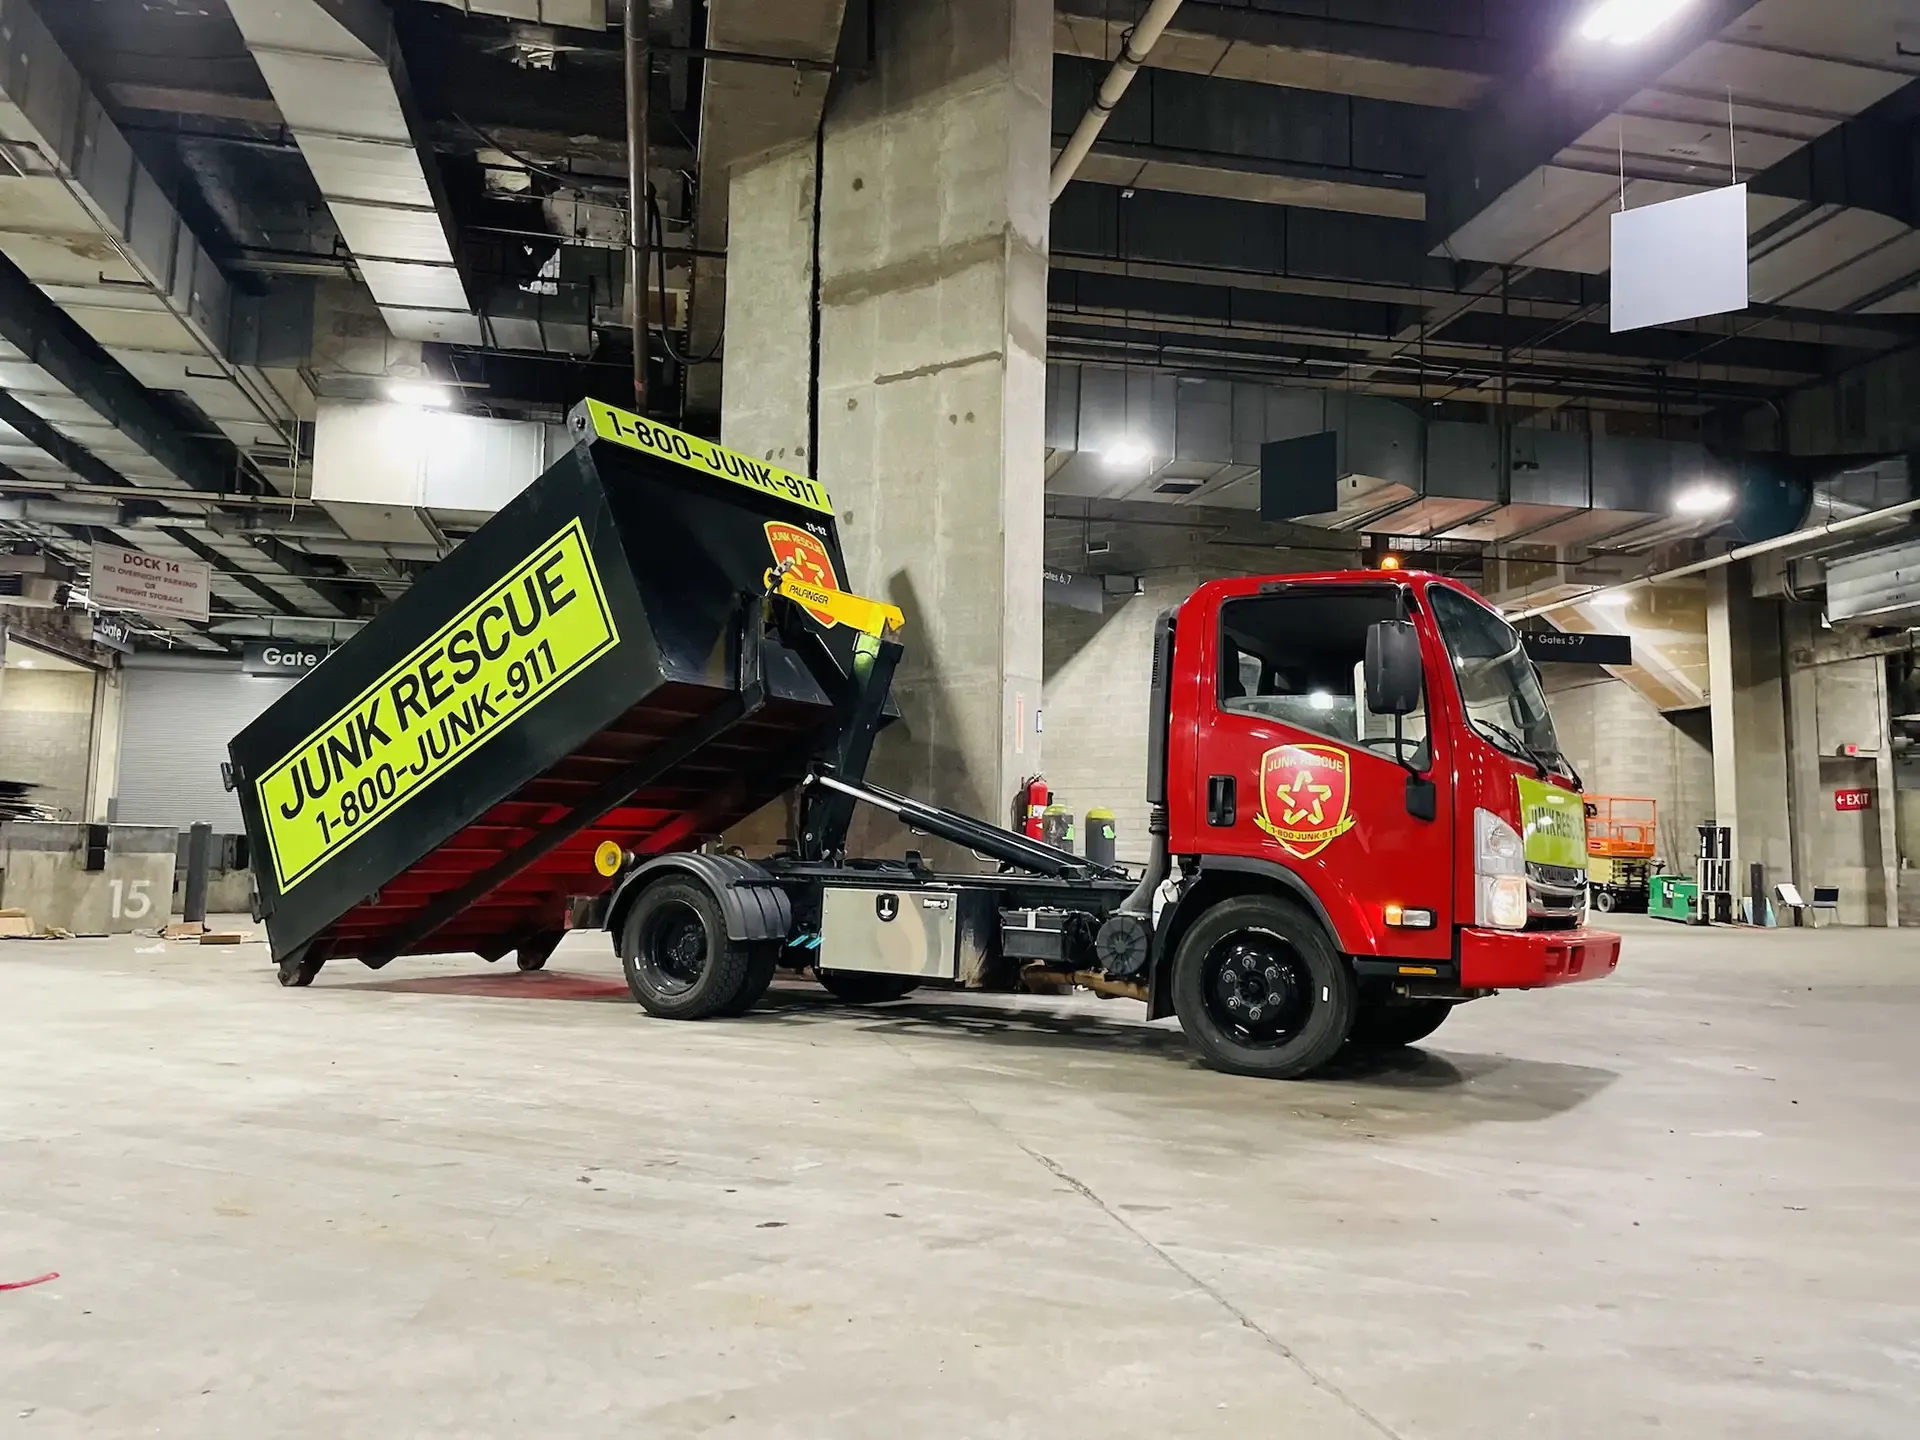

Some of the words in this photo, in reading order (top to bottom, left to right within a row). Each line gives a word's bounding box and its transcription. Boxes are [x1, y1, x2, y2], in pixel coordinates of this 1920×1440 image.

[606, 410, 821, 506] 1-800-JUNK-911
[771, 531, 793, 542] JUNK
[791, 533, 825, 557] RESCUE
[123, 553, 161, 571] DOCK
[165, 562, 180, 574] 14
[102, 564, 116, 573] NO
[117, 568, 162, 582] OVERNIGHT
[163, 577, 198, 589] PARKING
[144, 582, 156, 590] OR
[1043, 571, 1059, 582] ates
[116, 585, 147, 597] FREIGHT
[149, 591, 184, 604] STORAGE
[788, 584, 829, 605] PALFINGER
[101, 617, 122, 641] Gate
[1538, 634, 1566, 645] Gates
[1568, 635, 1585, 645] 5-7
[262, 647, 317, 667] Gate
[279, 697, 392, 820] JUNK
[389, 549, 578, 732] RESCUE
[315, 637, 559, 846] 1-800-JUNK-911
[1267, 755, 1297, 772] JUNK
[1300, 756, 1343, 773] RESCUE
[1846, 793, 1868, 806] EXIT
[1271, 827, 1338, 840] 1-800-JUNK-911
[110, 879, 152, 919] 15
